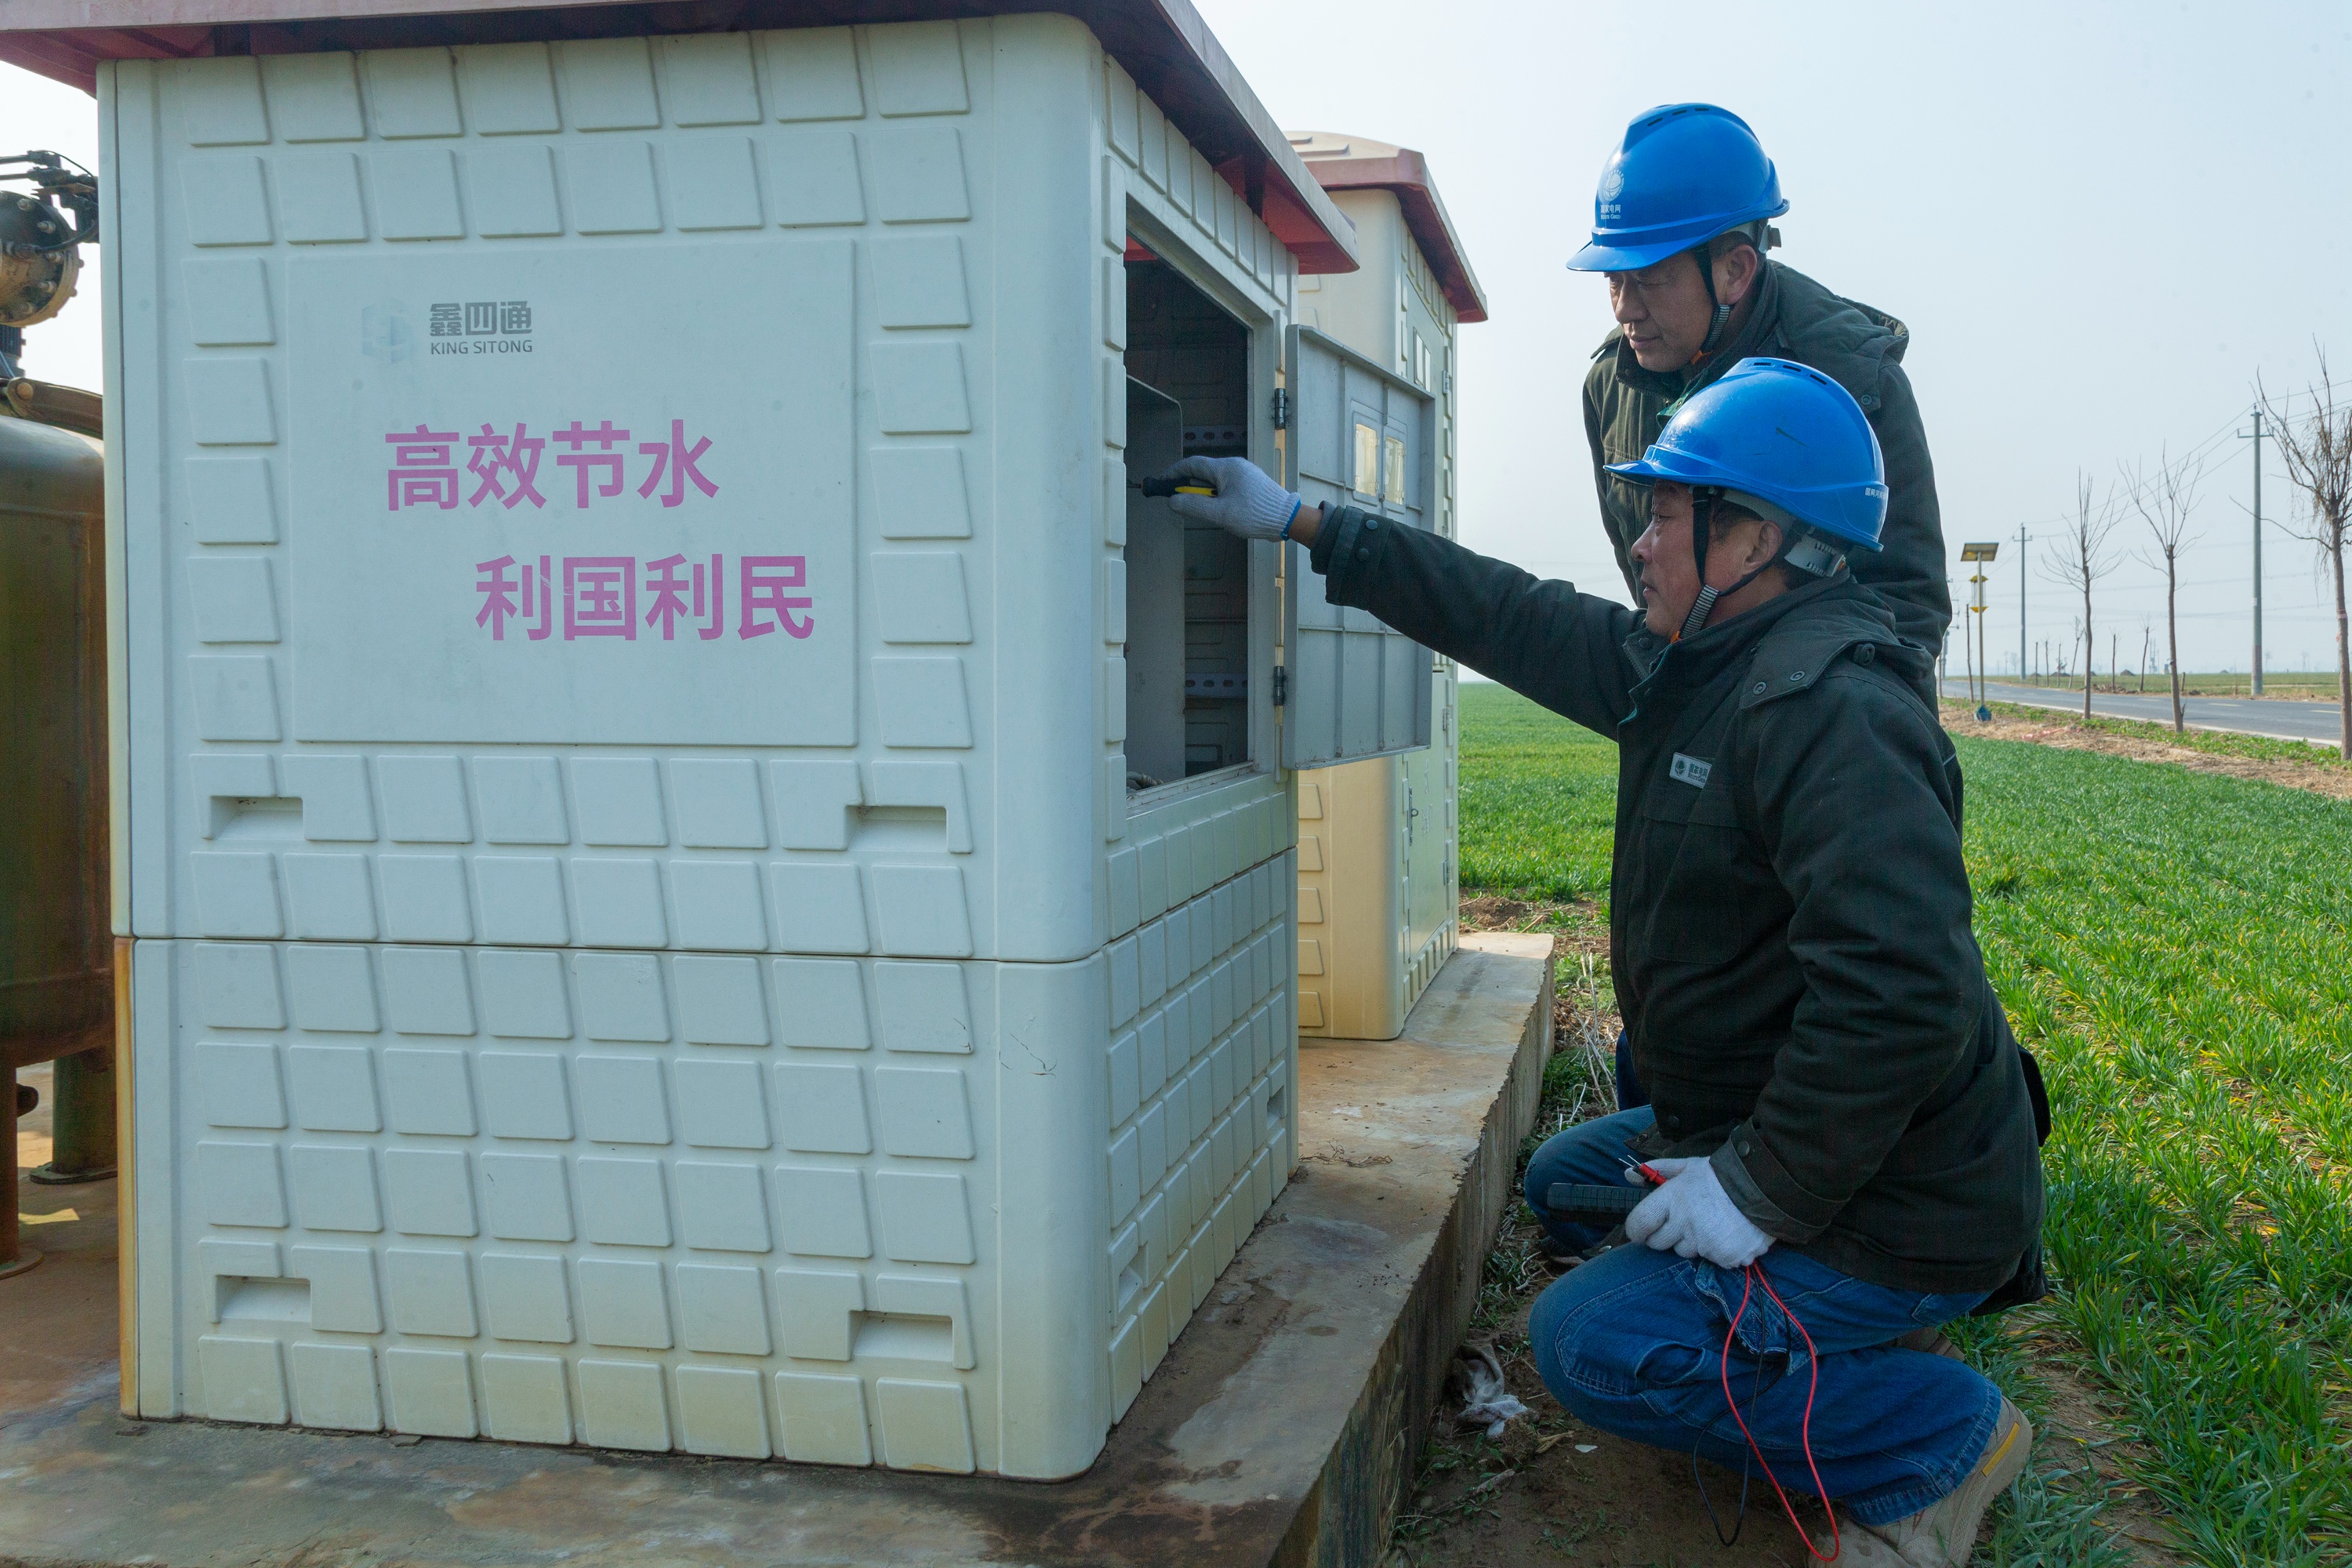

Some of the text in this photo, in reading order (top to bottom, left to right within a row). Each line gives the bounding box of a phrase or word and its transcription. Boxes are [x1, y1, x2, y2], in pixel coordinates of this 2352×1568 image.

[429, 301, 533, 336] 鑫四通
[430, 339, 533, 355] KING SITONG
[385, 419, 720, 510] 高效节水
[475, 554, 815, 641] 利国利民
